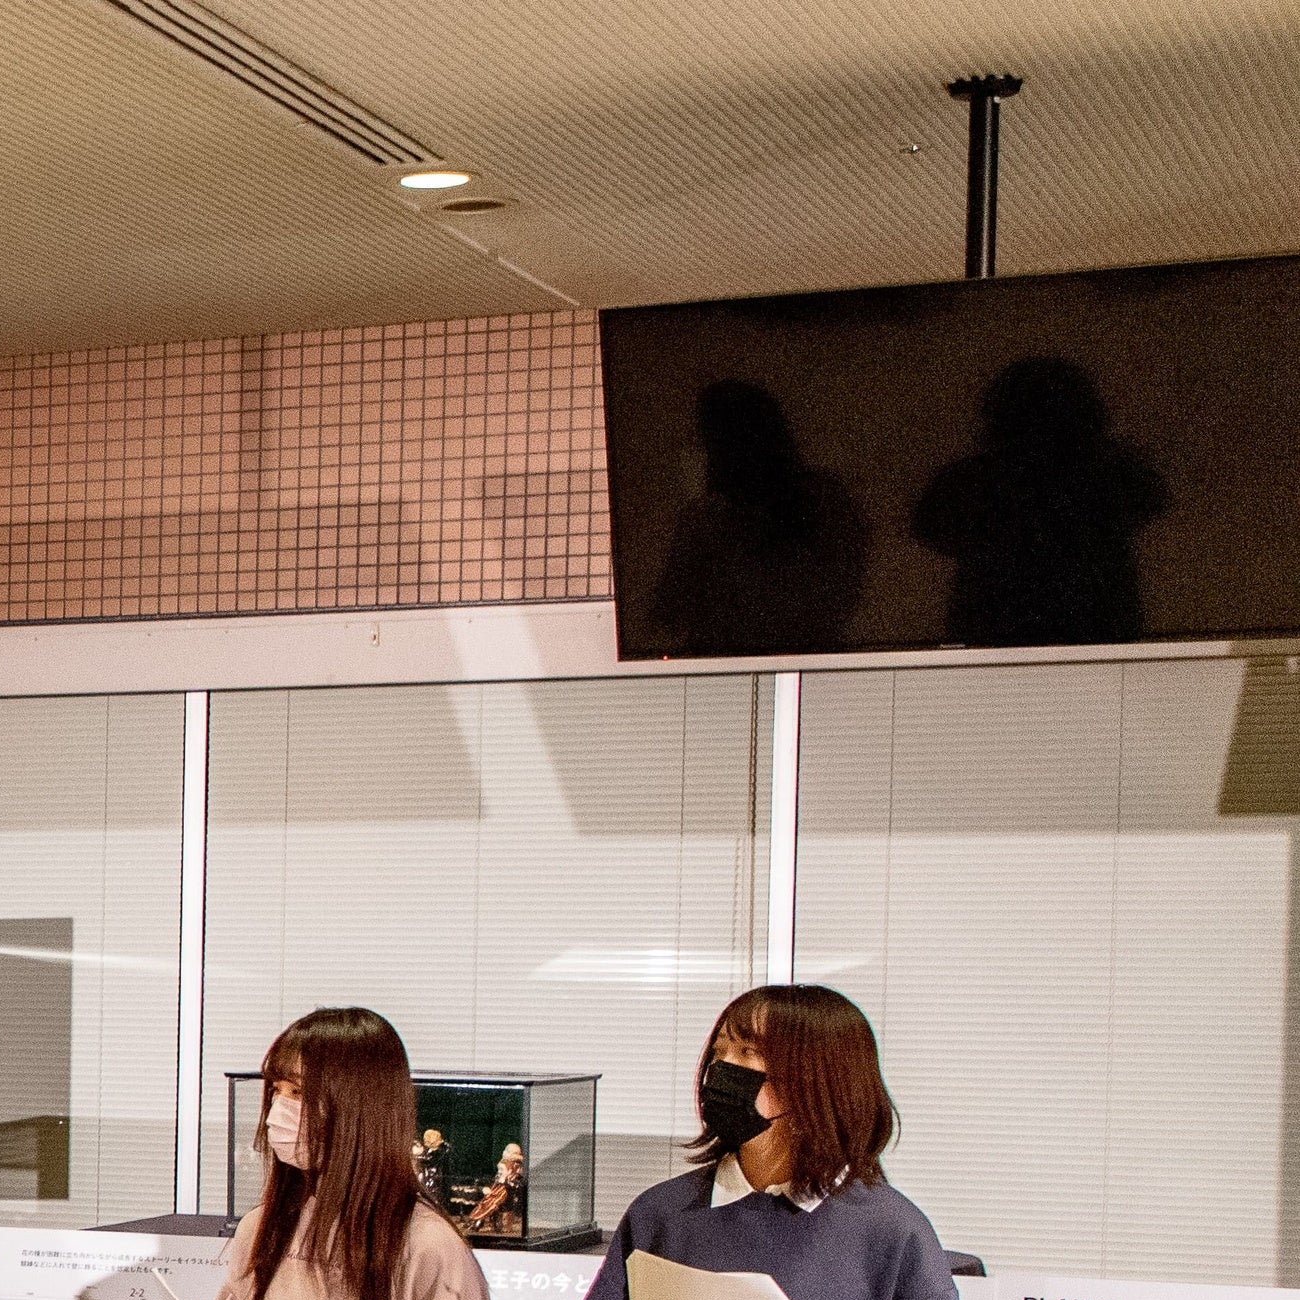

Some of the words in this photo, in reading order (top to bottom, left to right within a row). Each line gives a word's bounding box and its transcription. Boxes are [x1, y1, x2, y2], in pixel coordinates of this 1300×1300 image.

[488, 1269, 590, 1293] 王子の今と
[129, 1288, 145, 1298] 2-2
